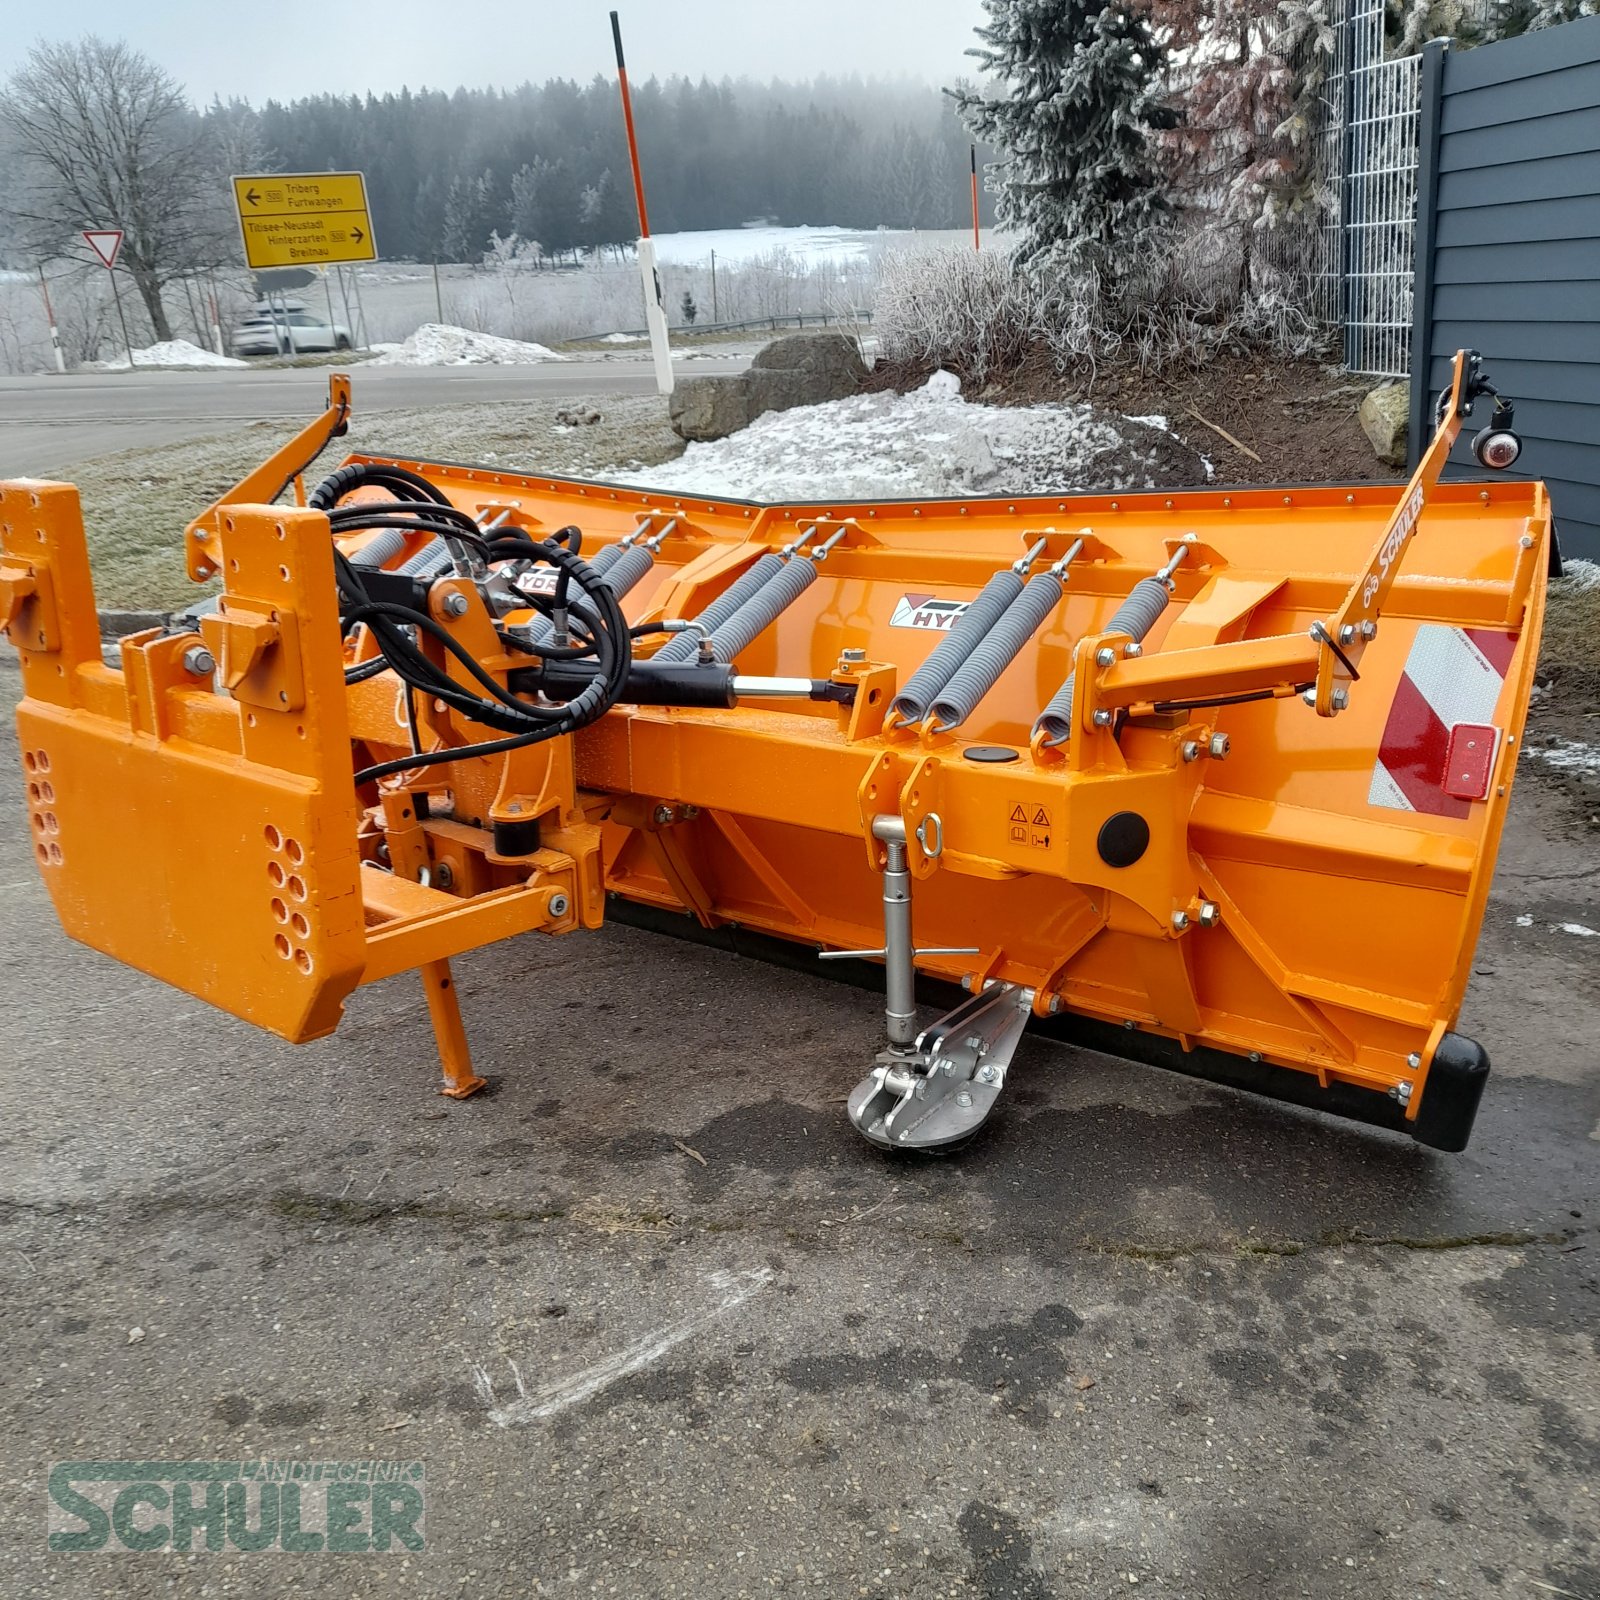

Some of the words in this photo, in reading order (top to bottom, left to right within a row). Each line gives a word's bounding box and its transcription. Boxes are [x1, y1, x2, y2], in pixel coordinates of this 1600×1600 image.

[285, 184, 320, 194] Triberg
[287, 197, 343, 208] Furtwangen
[247, 220, 324, 232] Titisee-Neustadt
[267, 234, 327, 245] Hinterzarten
[289, 247, 329, 258] Breitnau
